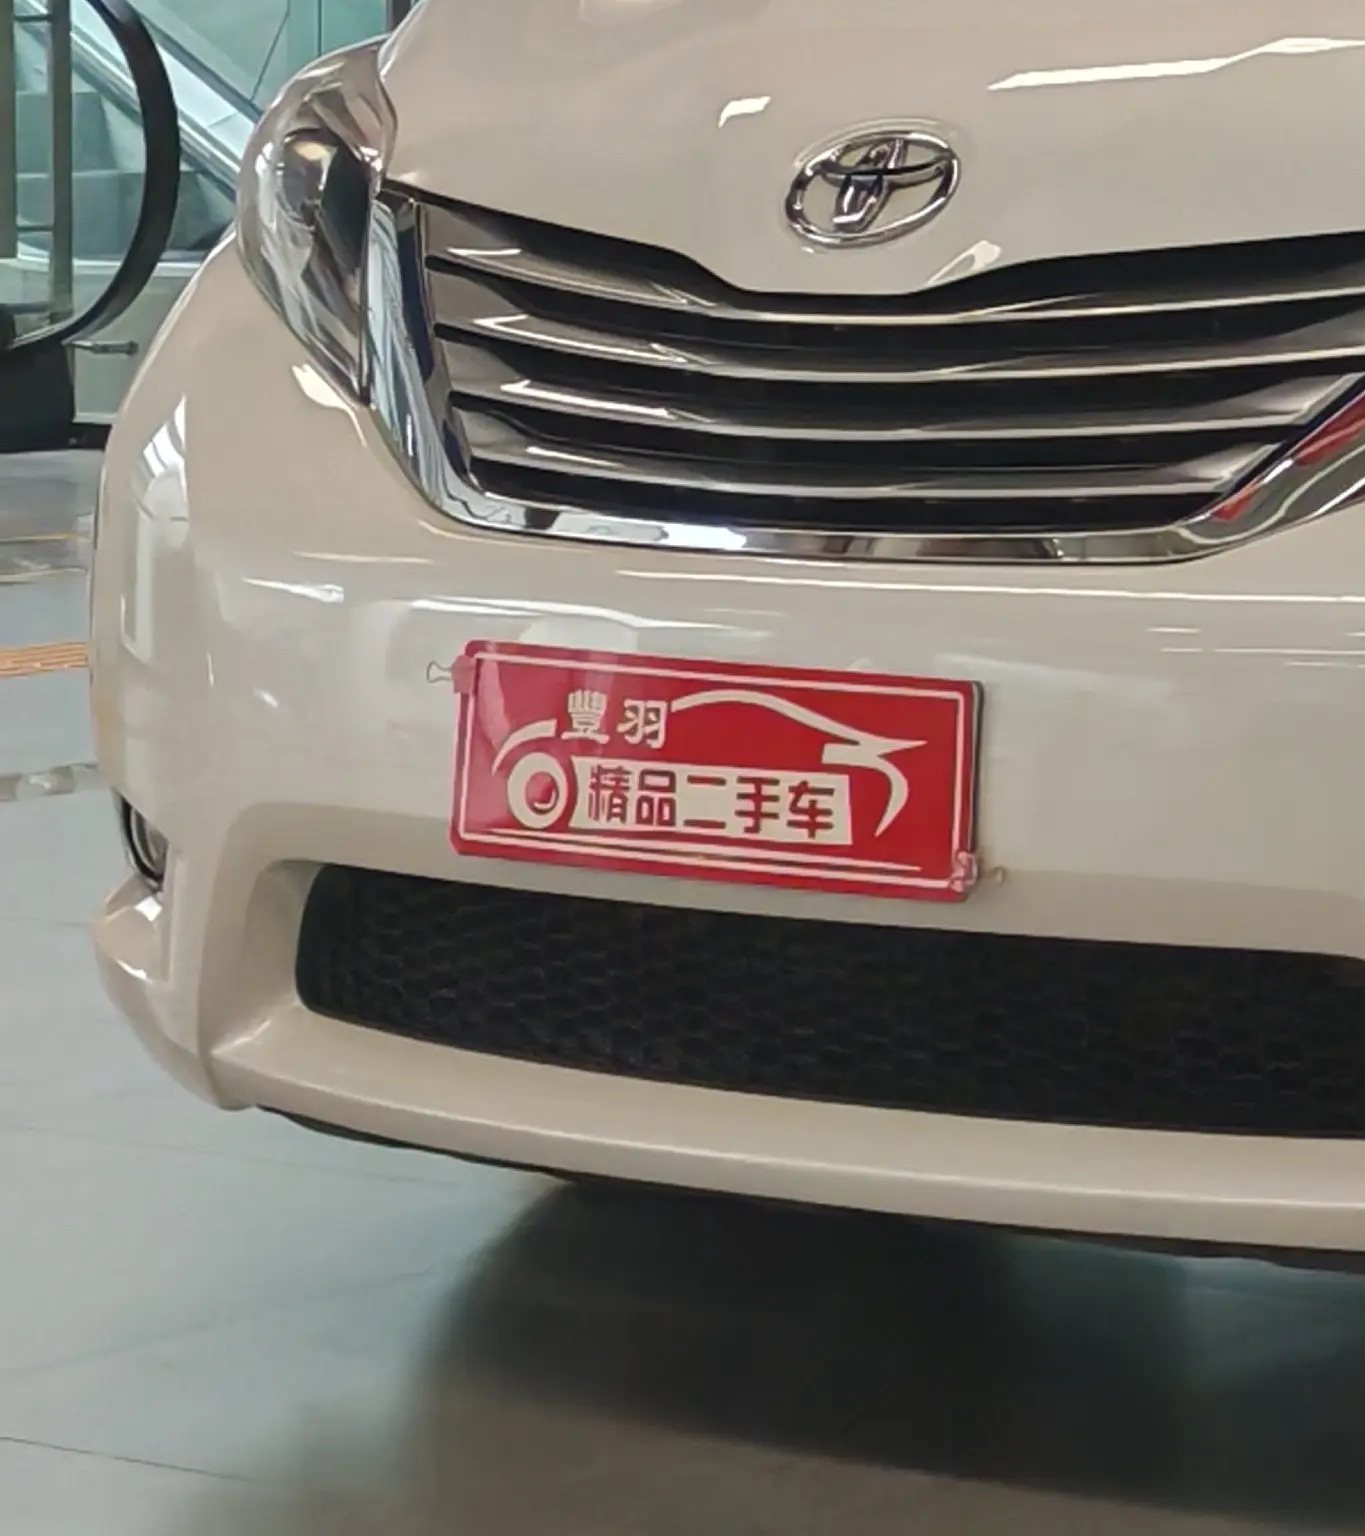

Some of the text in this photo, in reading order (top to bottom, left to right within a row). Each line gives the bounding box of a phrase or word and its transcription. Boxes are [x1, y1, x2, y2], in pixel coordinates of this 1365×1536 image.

[587, 764, 836, 840] 精品二手车
